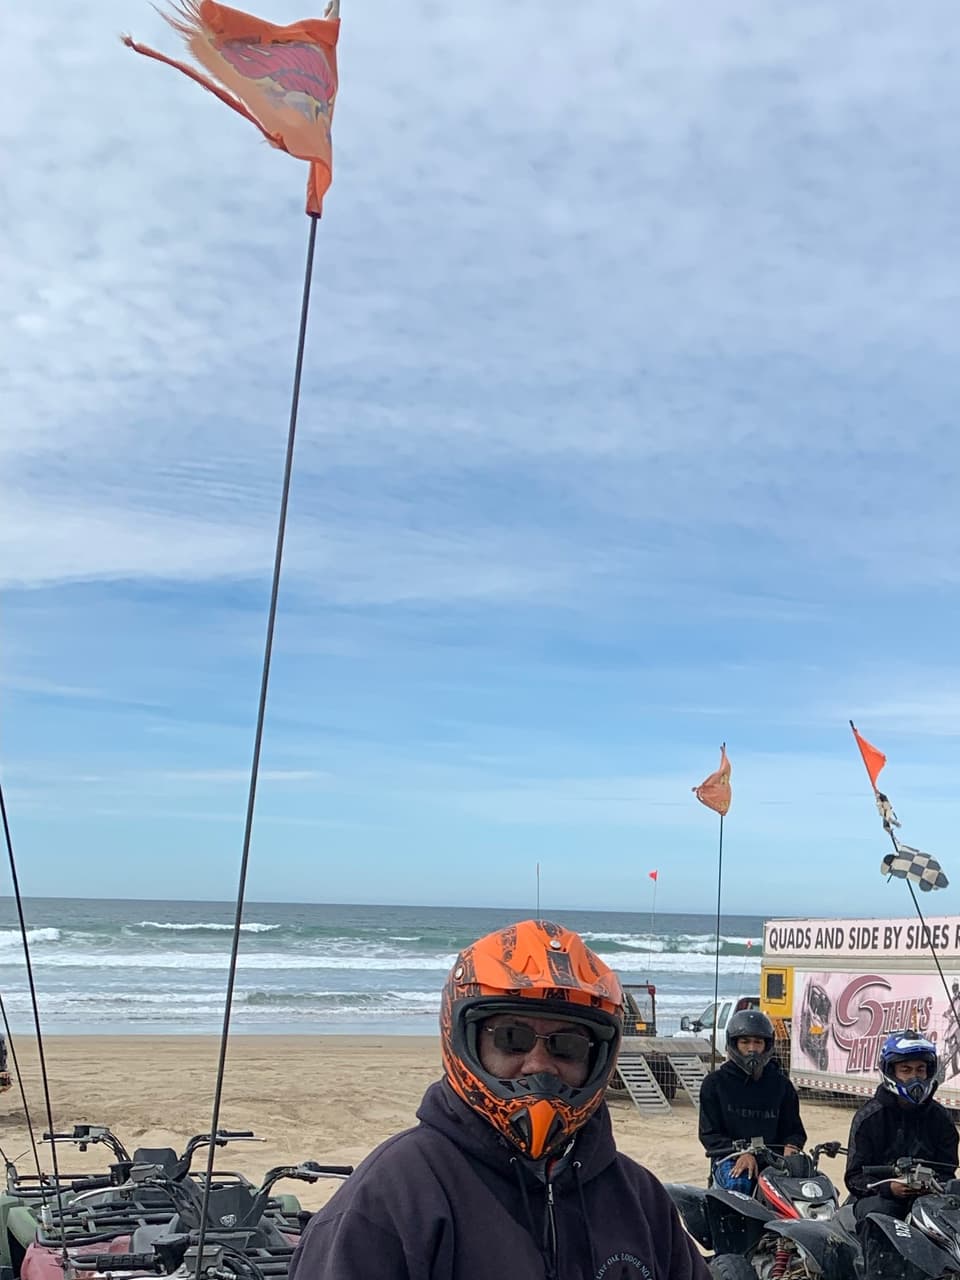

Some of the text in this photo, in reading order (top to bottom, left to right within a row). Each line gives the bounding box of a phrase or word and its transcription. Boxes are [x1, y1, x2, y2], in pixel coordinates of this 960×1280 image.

[769, 927, 811, 951] QUADS
[815, 927, 844, 949] AND
[849, 926, 879, 949] SIDE
[883, 925, 903, 949] BY
[906, 924, 949, 949] SIDES
[596, 1264, 608, 1280] LIVE
[607, 1254, 620, 1265] OAK
[621, 1252, 641, 1268] LODGE
